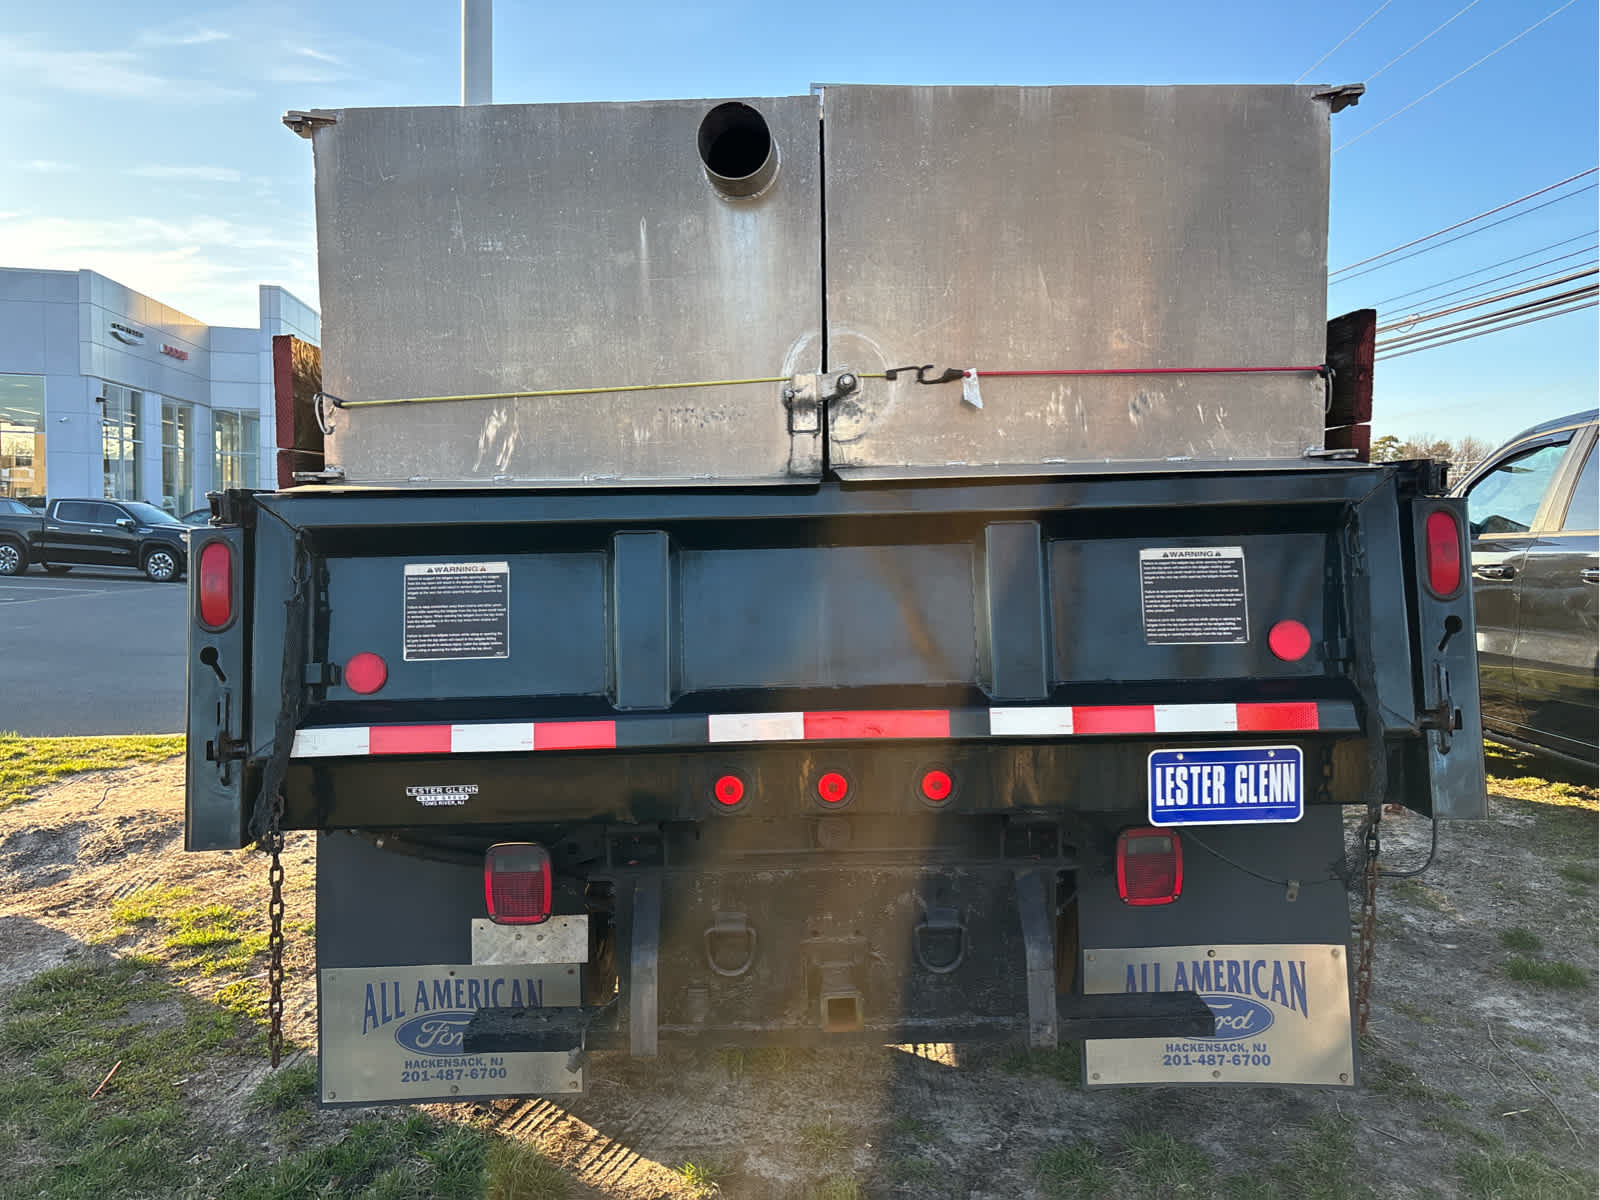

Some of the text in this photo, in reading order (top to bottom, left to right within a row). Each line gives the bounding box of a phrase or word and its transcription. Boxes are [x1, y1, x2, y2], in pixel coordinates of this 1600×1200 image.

[1169, 550, 1213, 558] WARNING
[435, 565, 479, 573] WARNING
[406, 785, 479, 796] LESTER GLENN
[1155, 763, 1297, 807] LESTER GLENN
[1174, 960, 1308, 1019] AMERICAN
[363, 979, 543, 1036] ALL AMERICAN
[1165, 1043, 1266, 1054] HACKENSACK, NJ
[404, 1057, 504, 1069] HACKENSACK, NJ
[1163, 1055, 1271, 1067] 201-487-6700
[401, 1068, 507, 1083] 201-487-6700
